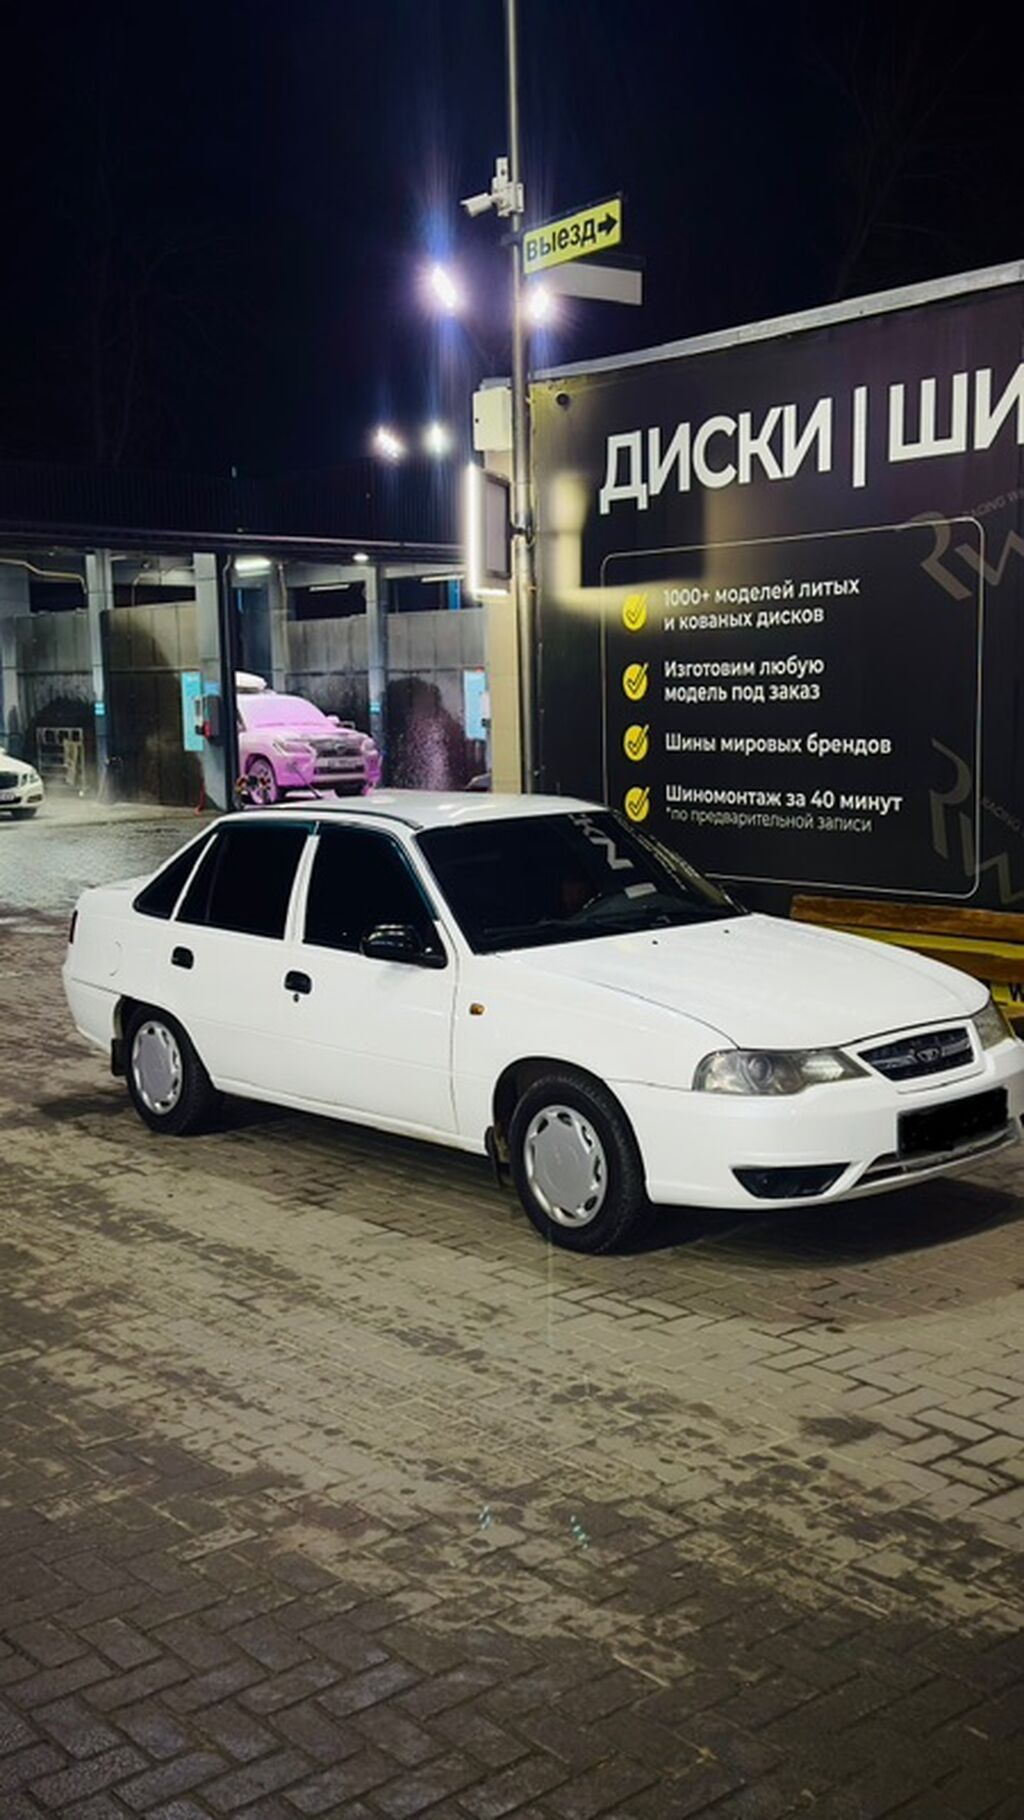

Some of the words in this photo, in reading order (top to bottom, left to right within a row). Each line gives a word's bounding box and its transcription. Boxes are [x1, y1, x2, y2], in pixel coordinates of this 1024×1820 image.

[599, 397, 832, 515] ДИСКИ
[888, 362, 1024, 463] ШИ
[664, 588, 710, 608] 1000+
[715, 579, 795, 604] моделей
[799, 578, 861, 598] литых
[664, 616, 675, 631] и
[679, 612, 753, 630] кованых
[756, 607, 825, 629] дисков
[664, 660, 755, 678] Изготовим
[759, 654, 825, 679] любую
[664, 685, 728, 704] модель
[731, 684, 765, 703] под
[768, 683, 821, 701] заказ
[665, 732, 716, 751] Шины
[720, 737, 802, 756] мировых
[806, 732, 891, 757] брендов
[665, 784, 781, 807] Шиномонтаж
[785, 791, 806, 808] за
[810, 790, 835, 809] 40
[839, 795, 903, 815] минут
[690, 808, 814, 831] предварительной
[816, 816, 872, 833] записи
